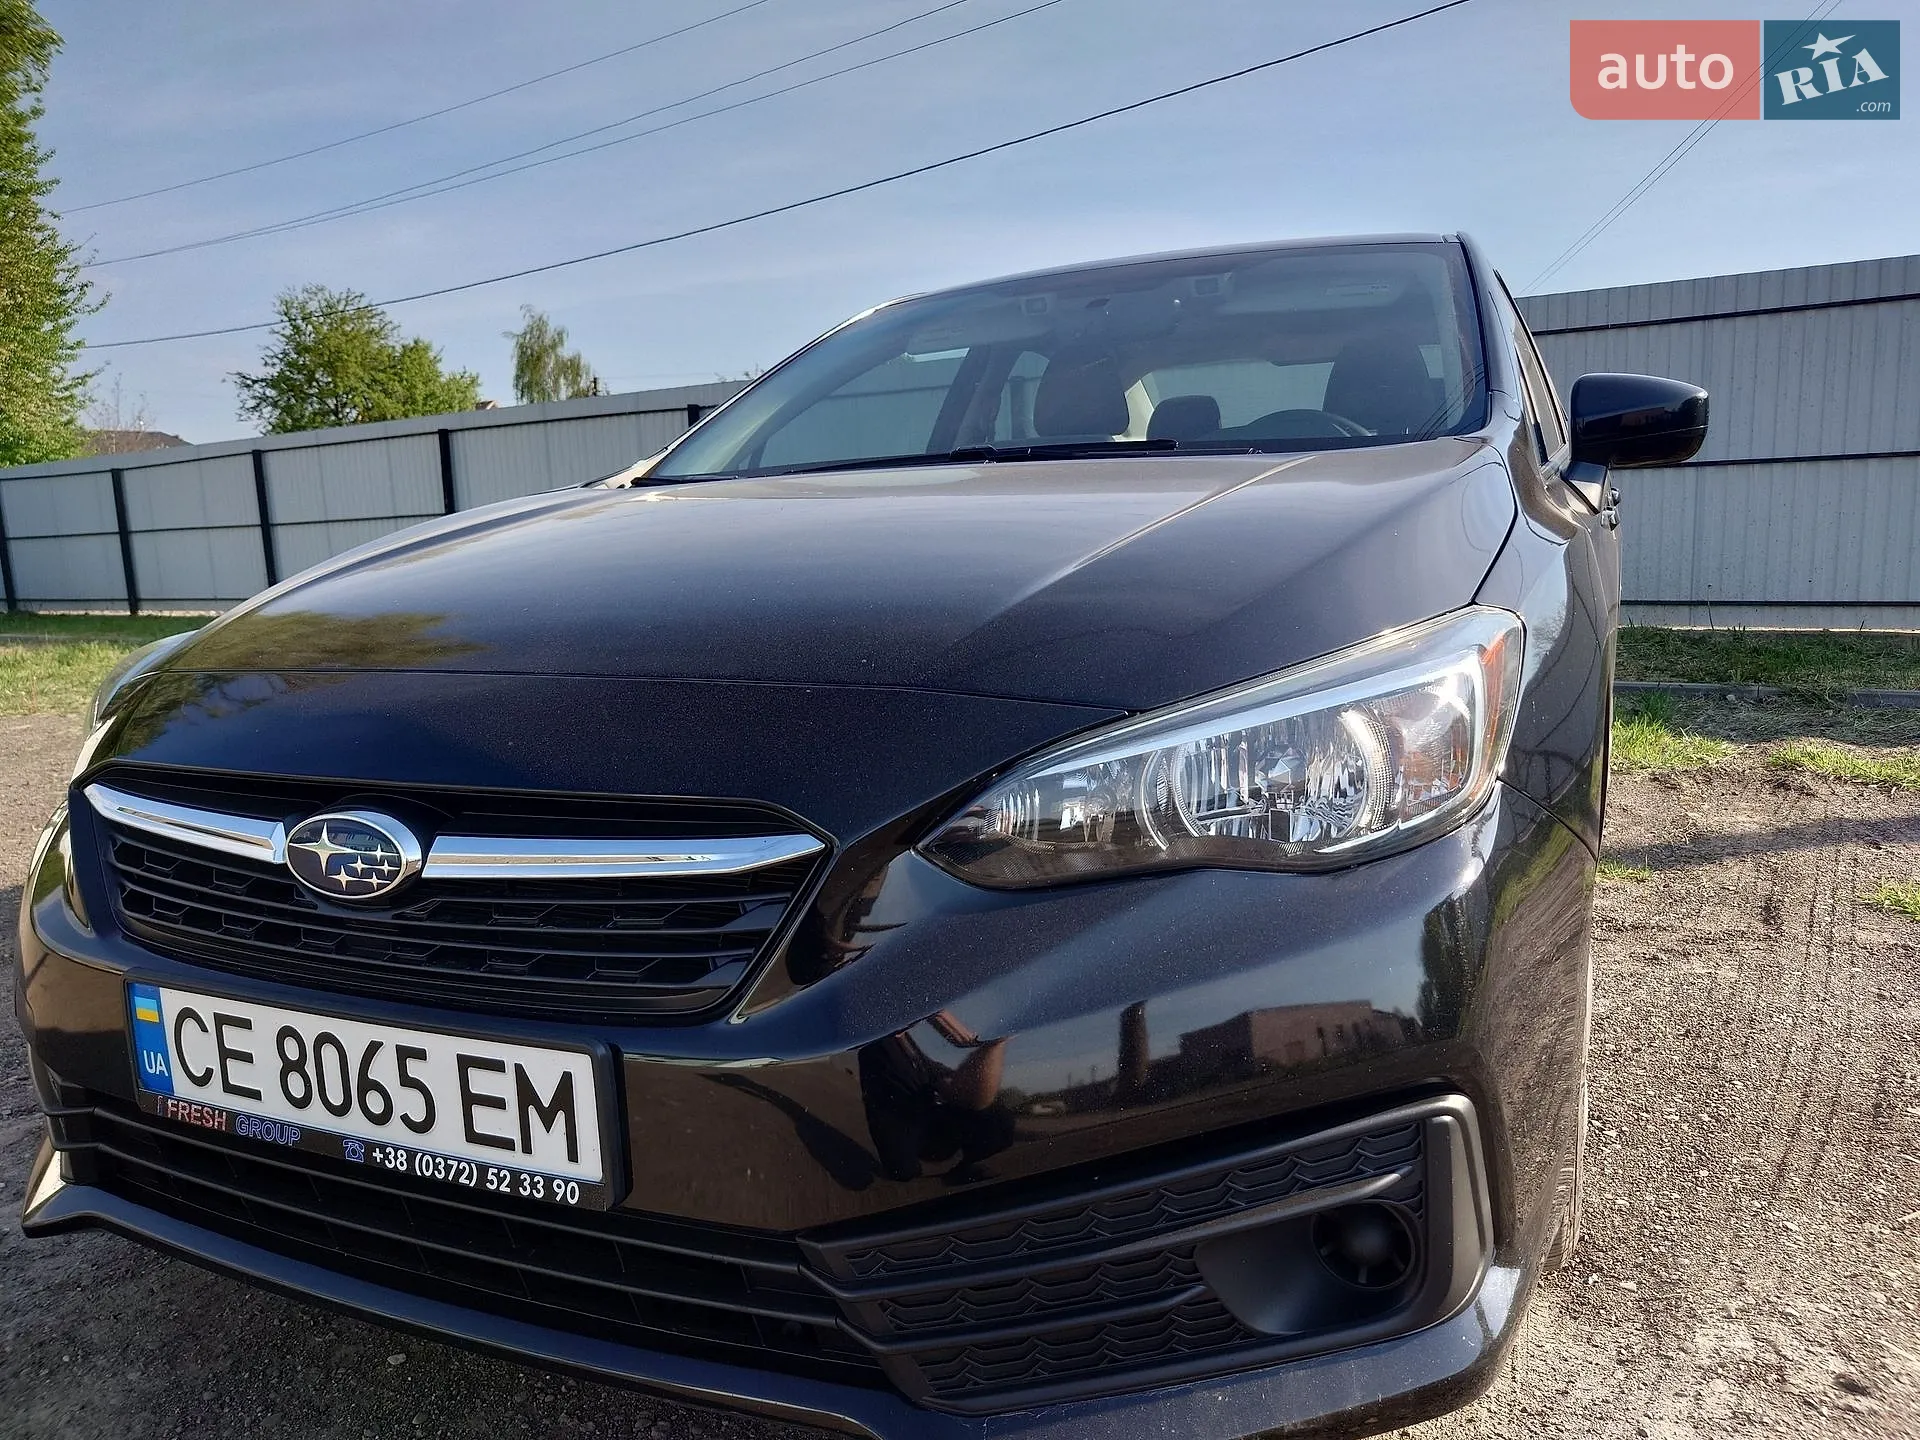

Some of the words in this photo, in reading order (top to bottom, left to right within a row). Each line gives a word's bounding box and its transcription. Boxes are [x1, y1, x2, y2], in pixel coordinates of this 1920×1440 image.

[143, 1049, 169, 1077] UA
[173, 1006, 262, 1102] CE
[276, 1024, 437, 1135] 8065
[456, 1053, 580, 1164] EM
[166, 1098, 228, 1132] FRESH
[235, 1114, 301, 1146] GROUP
[372, 1146, 408, 1171] +38
[414, 1152, 478, 1187] (0372)
[485, 1167, 511, 1193] 52
[518, 1172, 545, 1199] 33
[552, 1178, 580, 1205] 90
